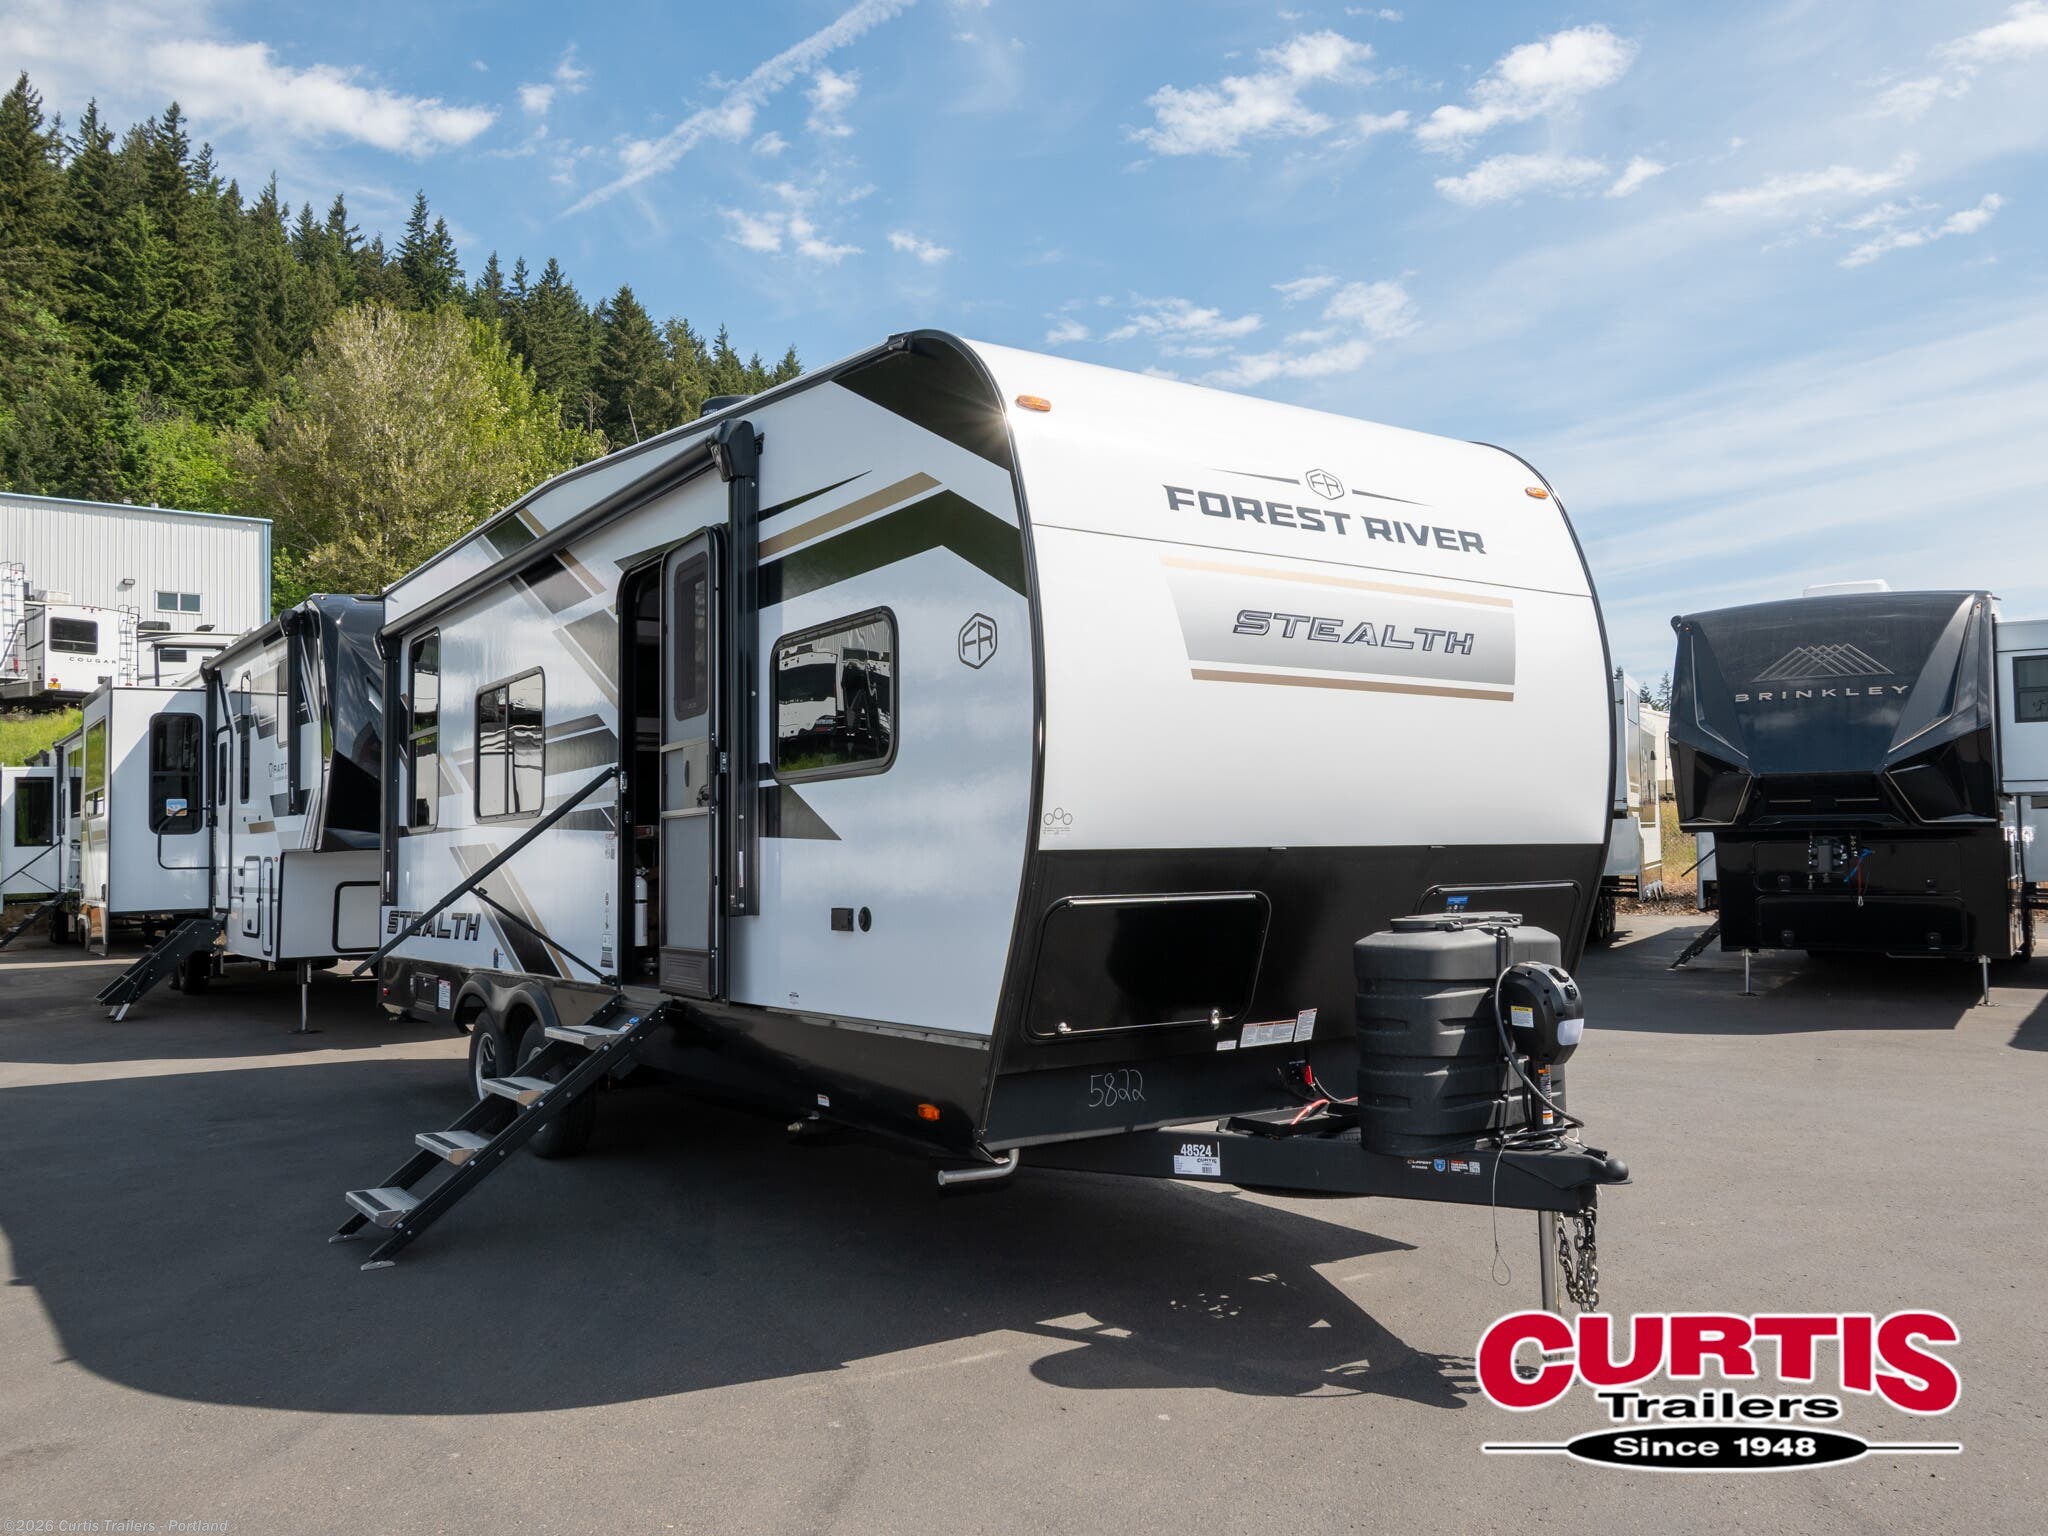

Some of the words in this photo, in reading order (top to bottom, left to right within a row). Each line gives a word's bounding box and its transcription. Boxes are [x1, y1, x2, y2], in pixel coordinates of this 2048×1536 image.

[1162, 484, 1351, 535] FOREST
[1360, 515, 1487, 555] RIVER
[1233, 609, 1474, 655] STEALTH
[69, 656, 117, 664] COUGAR
[1735, 685, 1908, 702] BRINKLEY
[387, 910, 481, 941] STEALTH
[1088, 1068, 1146, 1107] 5822
[1180, 1143, 1212, 1157] 48524
